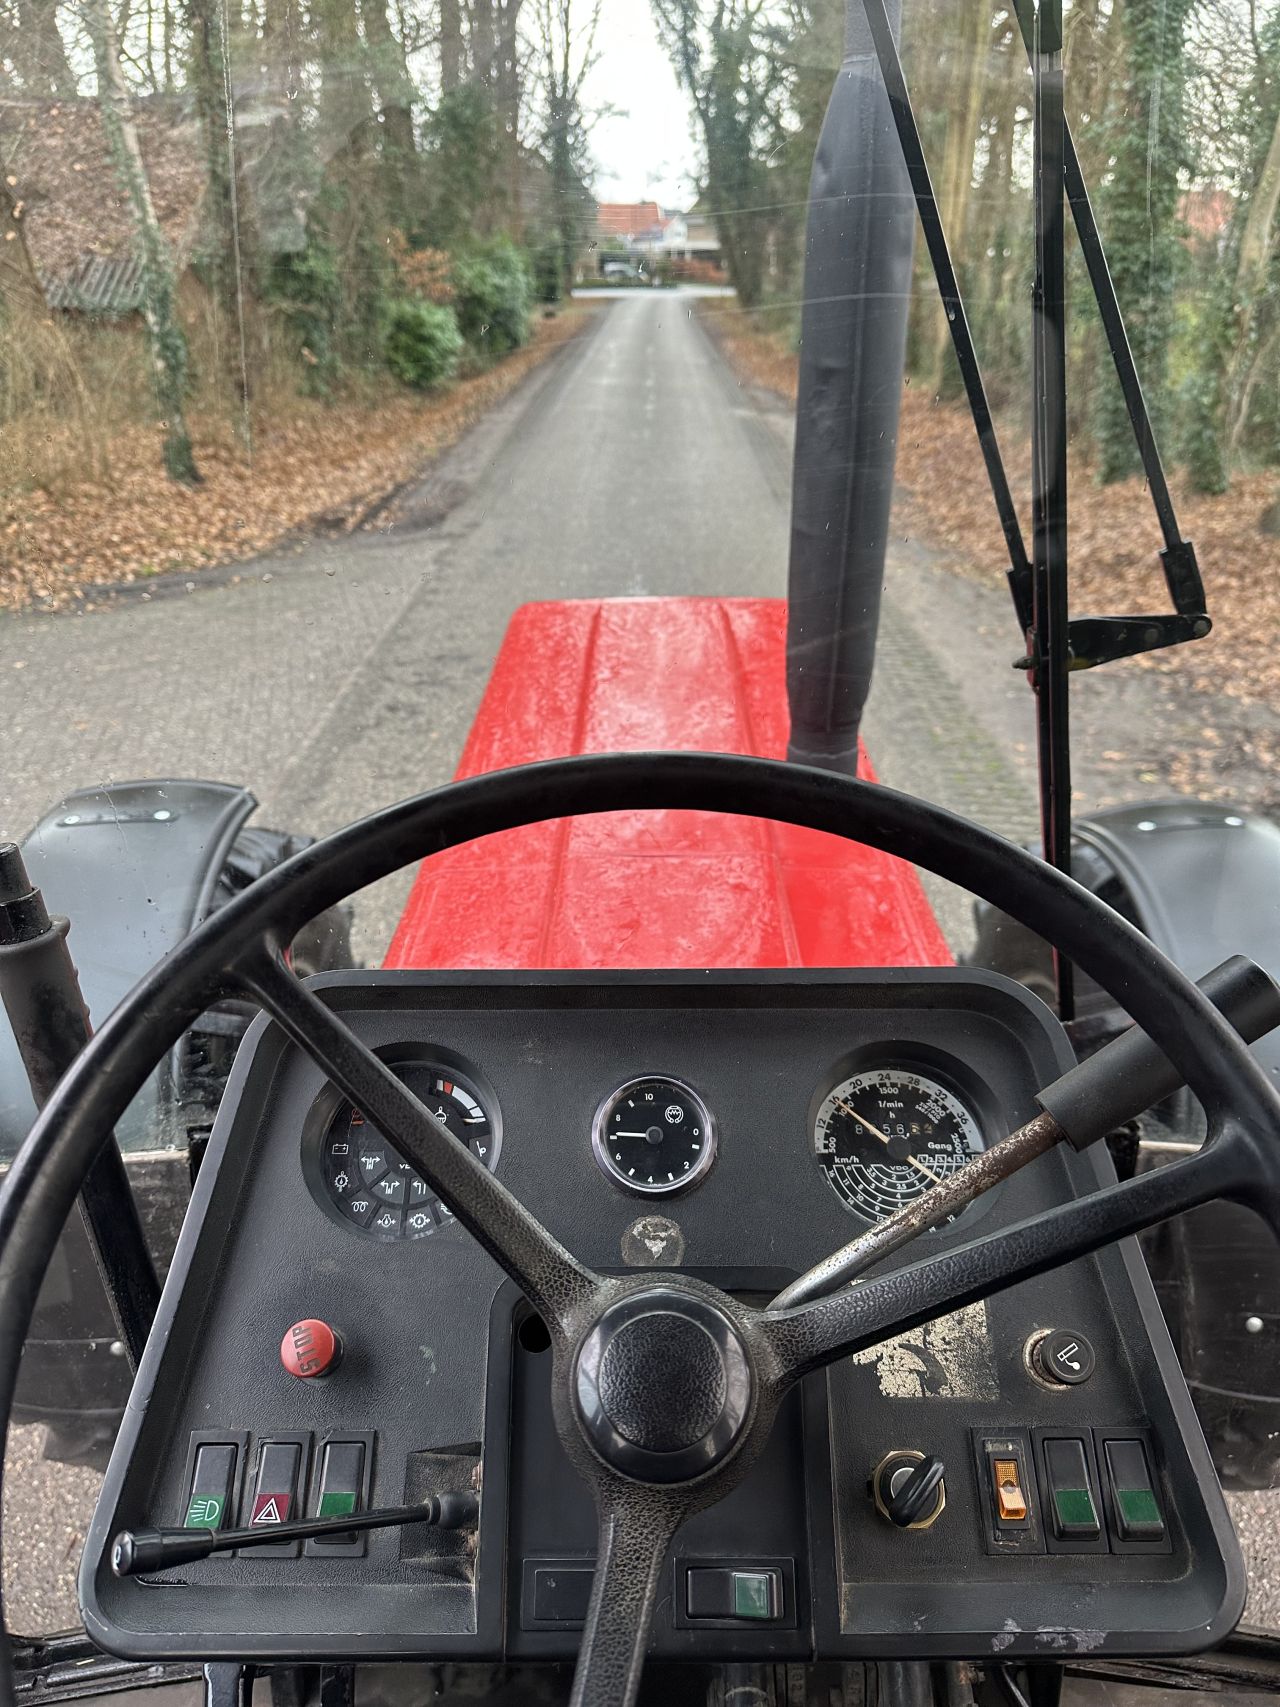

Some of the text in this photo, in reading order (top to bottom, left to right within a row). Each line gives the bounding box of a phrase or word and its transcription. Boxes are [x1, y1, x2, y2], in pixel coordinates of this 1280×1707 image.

[645, 1093, 654, 1101] 10
[816, 1118, 826, 1129] 12
[849, 1079, 862, 1089] 20
[877, 1073, 891, 1081] 24
[907, 1076, 920, 1086] 28
[934, 1089, 948, 1101] 32
[957, 1111, 969, 1125] 36
[890, 1111, 896, 1119] h
[926, 1099, 946, 1117] 2000
[951, 1133, 962, 1153] 2500
[693, 1128, 699, 1136] 0
[928, 1142, 952, 1151] Gang
[684, 1161, 689, 1169] 2
[856, 1194, 864, 1202] 10
[292, 1326, 320, 1373] STOP
